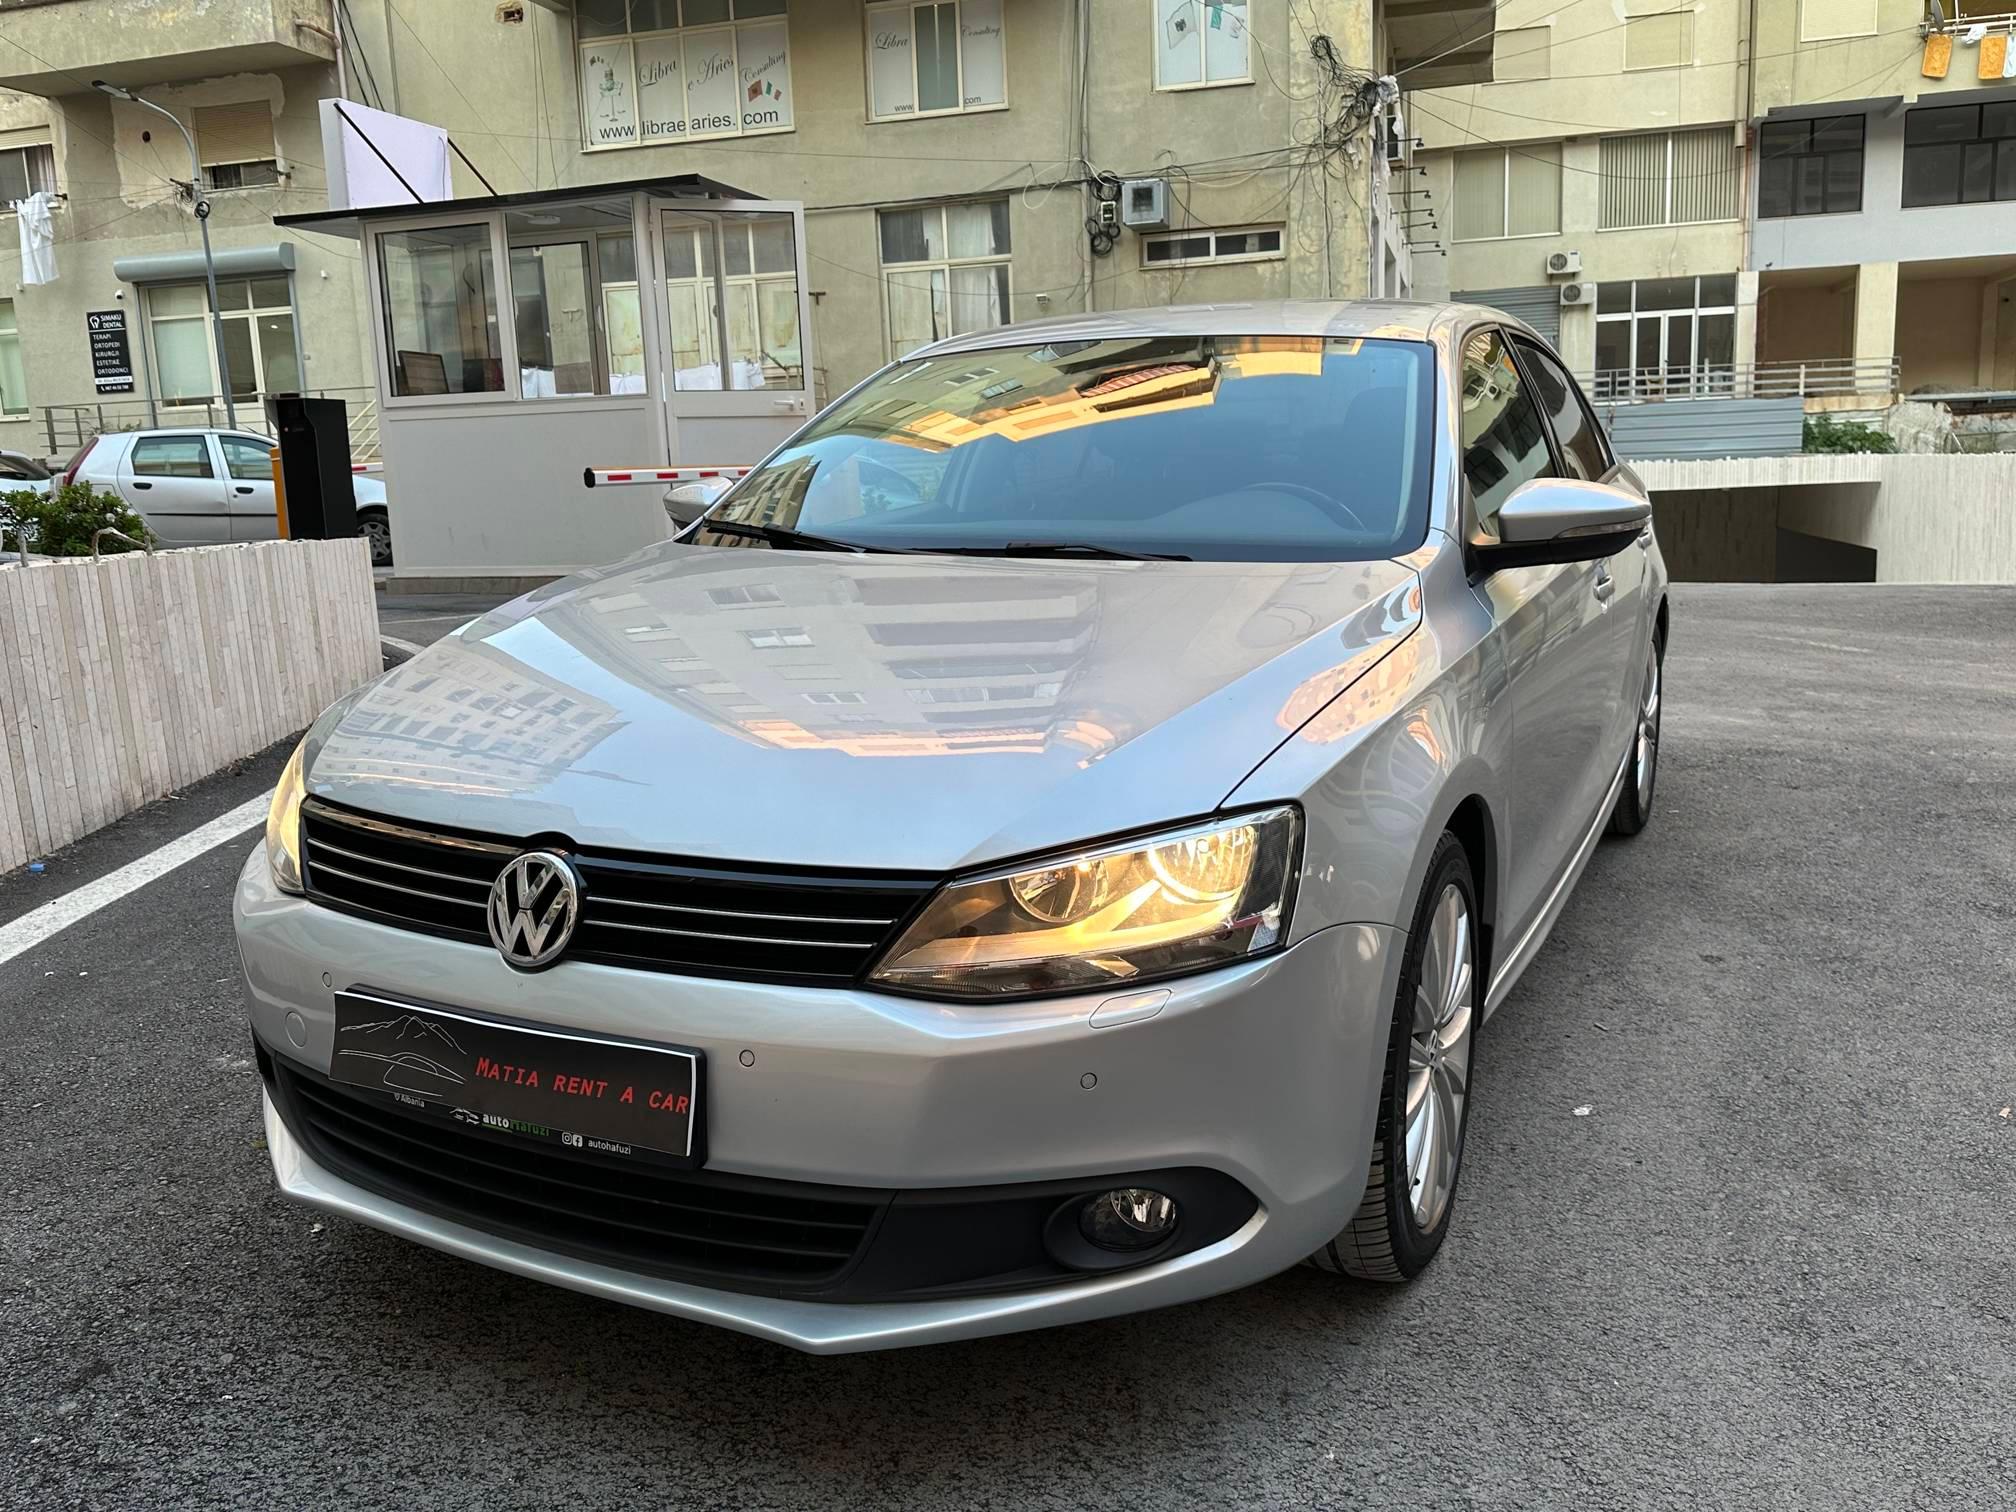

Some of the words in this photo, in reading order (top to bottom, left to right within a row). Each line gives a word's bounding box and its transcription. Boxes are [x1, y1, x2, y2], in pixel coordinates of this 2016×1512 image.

[875, 32, 908, 50] Libra
[638, 60, 677, 88] Libra
[697, 52, 734, 85] Aries
[741, 49, 786, 83] Consulting
[102, 321, 123, 329] DENTAL
[94, 341, 120, 349] ORTOPEDI
[97, 367, 129, 375] ORTODONCI
[475, 1057, 539, 1088] MATIA
[553, 1074, 609, 1098] RENT
[619, 1086, 634, 1104] A
[648, 1090, 690, 1115] CAR
[587, 1139, 632, 1155] autohafuzi
